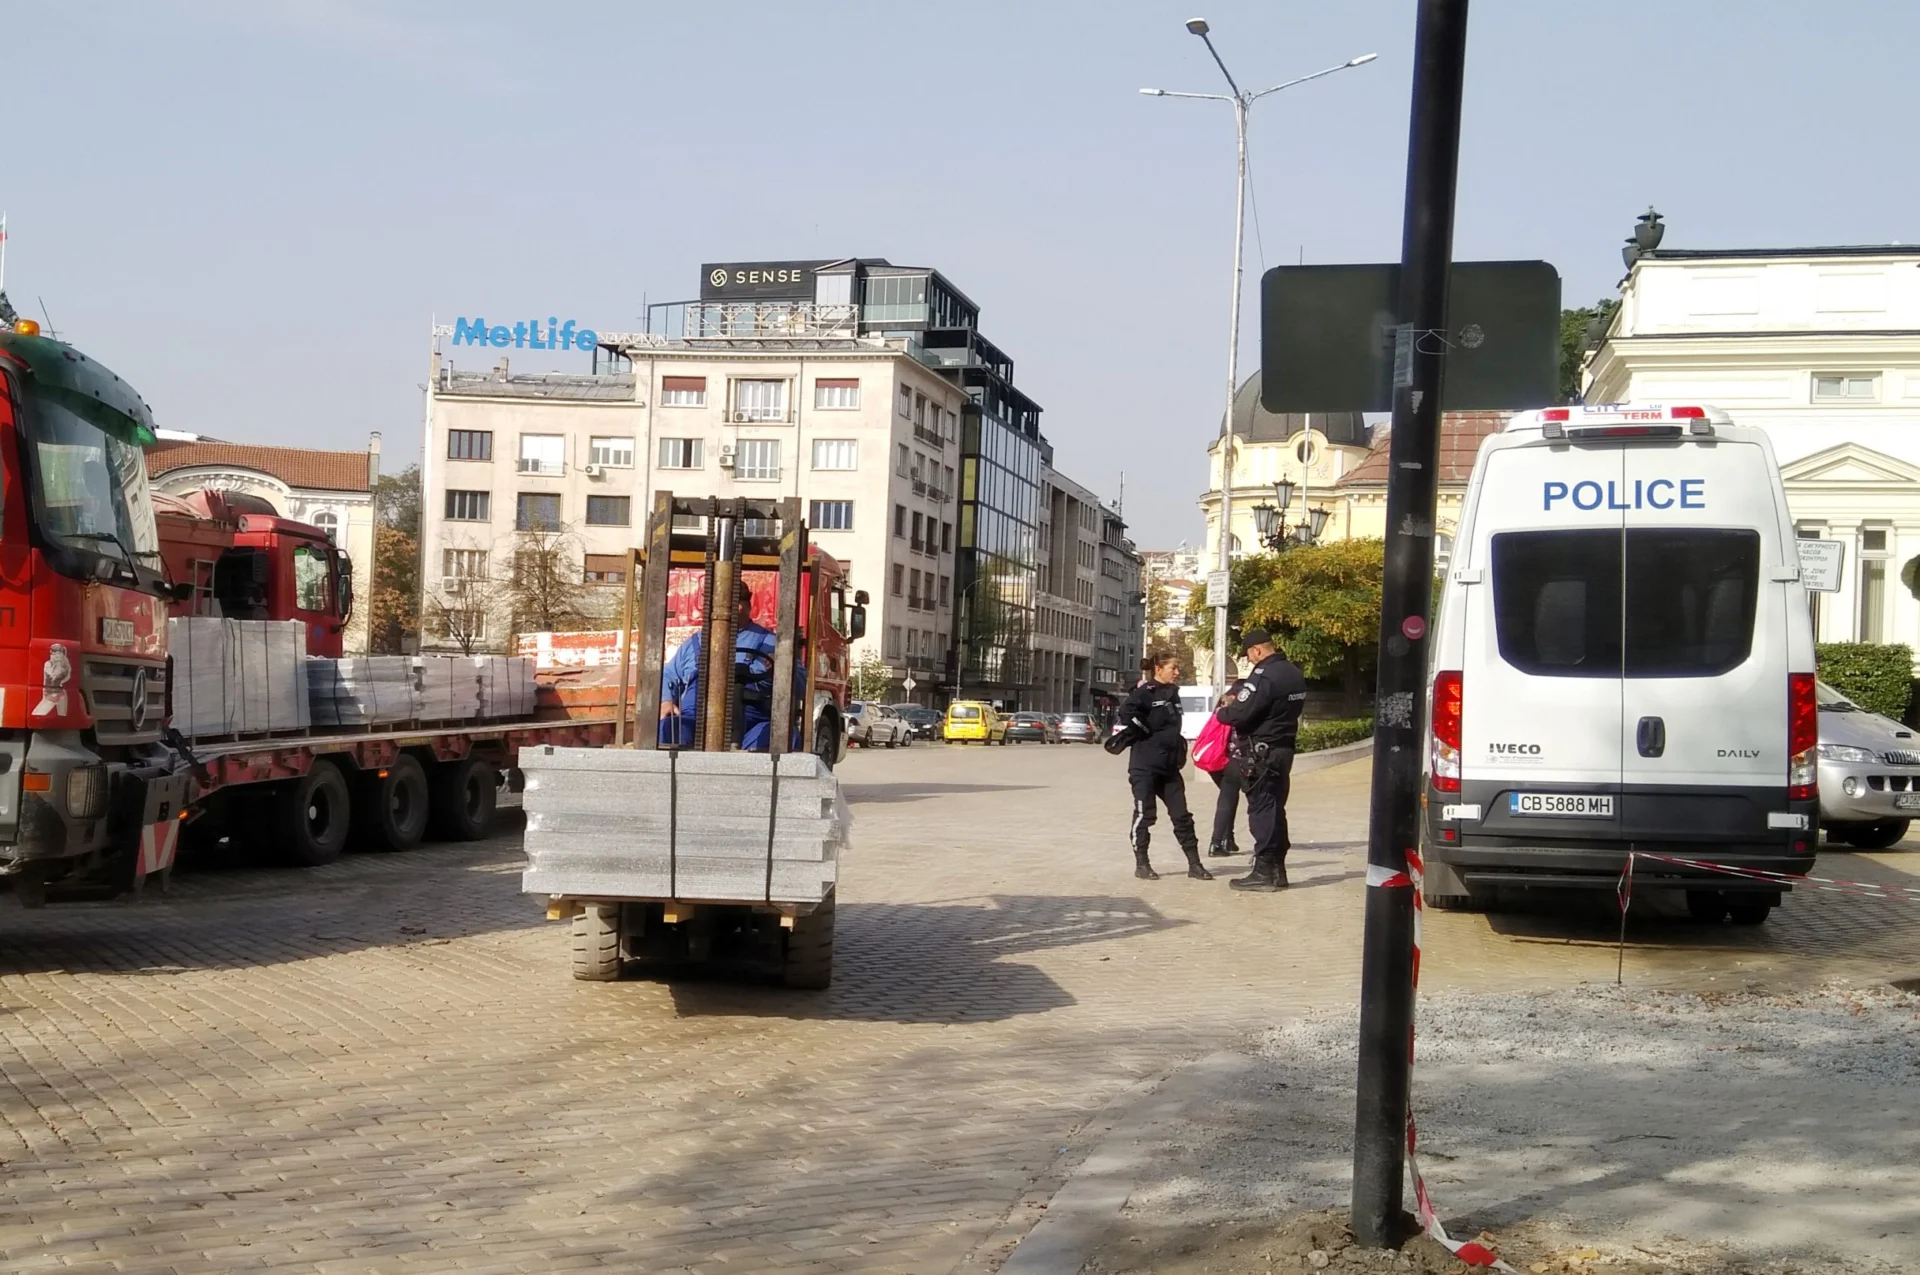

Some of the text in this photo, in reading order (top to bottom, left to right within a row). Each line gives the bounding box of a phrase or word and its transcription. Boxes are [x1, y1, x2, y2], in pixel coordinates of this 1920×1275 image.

[735, 269, 801, 284] SENSE
[452, 316, 598, 351] MetLife
[1621, 412, 1662, 420] TERM
[1544, 479, 1706, 511] POLICE
[1489, 743, 1541, 754] IVECO
[1717, 750, 1760, 758] DAILY
[1521, 796, 1542, 811] CB
[1545, 796, 1585, 812] 5888
[1588, 798, 1610, 813] MH
